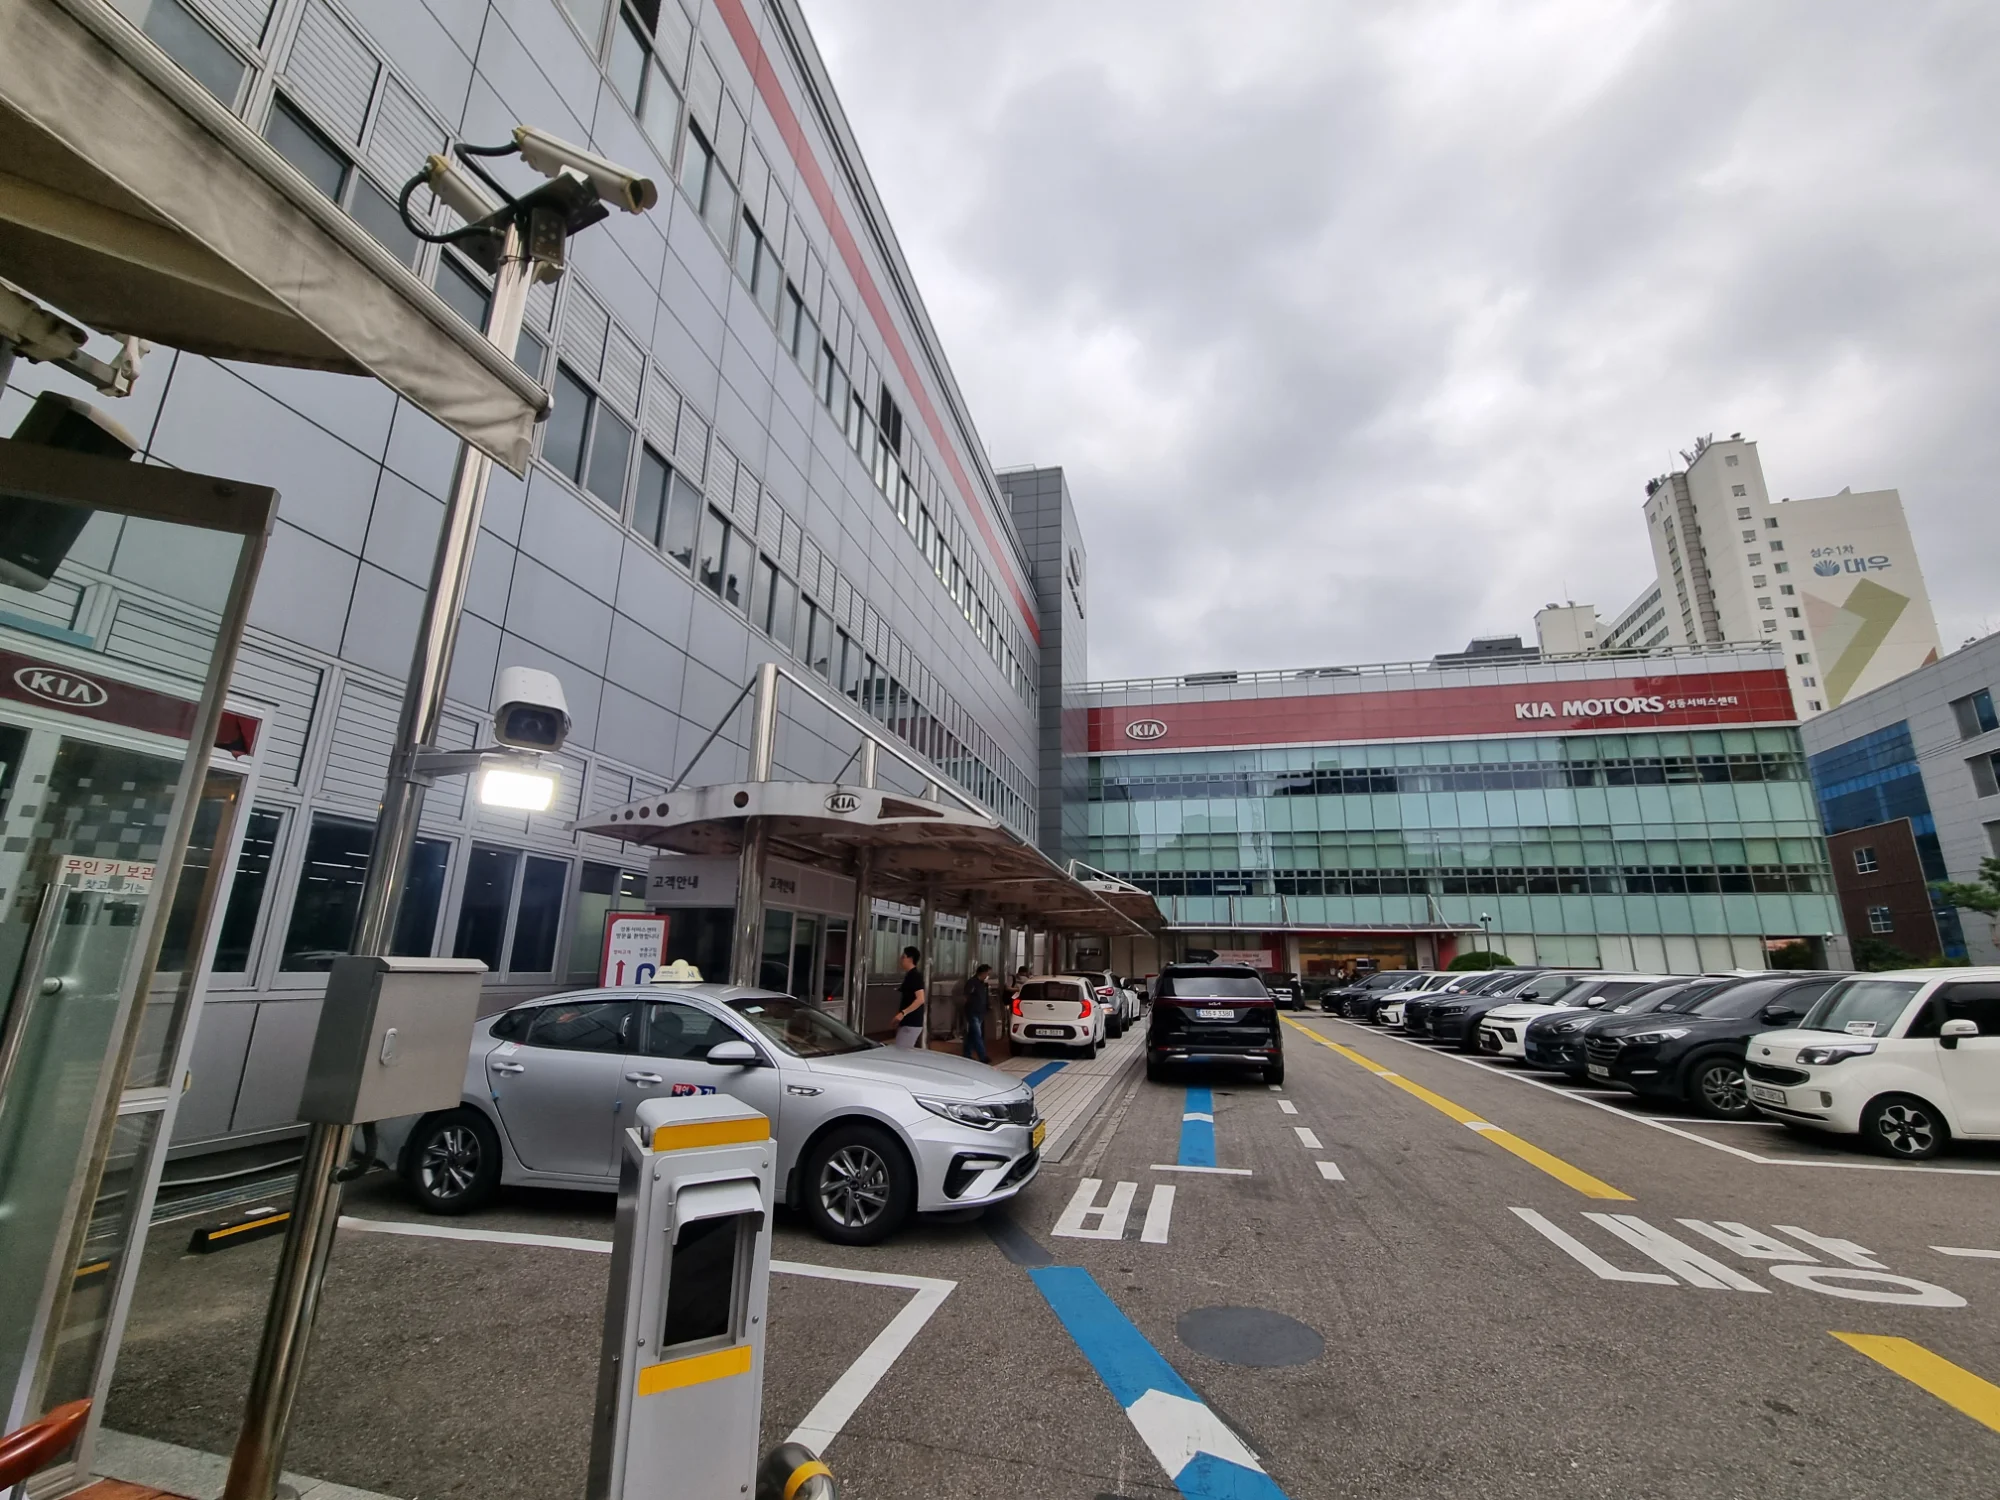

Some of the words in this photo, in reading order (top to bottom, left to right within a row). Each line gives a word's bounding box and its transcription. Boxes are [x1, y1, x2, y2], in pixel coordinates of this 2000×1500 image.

[1810, 545, 1854, 558] 성수1차
[1844, 555, 1892, 573] 대우
[30, 671, 91, 704] KIA
[1514, 702, 1556, 719] KIA
[1562, 696, 1666, 717] MOTORS
[1667, 695, 1738, 710] 성동서비스센터
[1132, 723, 1160, 737] KIA
[831, 793, 856, 810] KIA
[64, 859, 98, 876] 무인
[104, 863, 120, 876] 키
[653, 875, 699, 890] 고객안내
[769, 877, 796, 894] 고객안내
[1508, 1205, 1969, 1308] 내방
